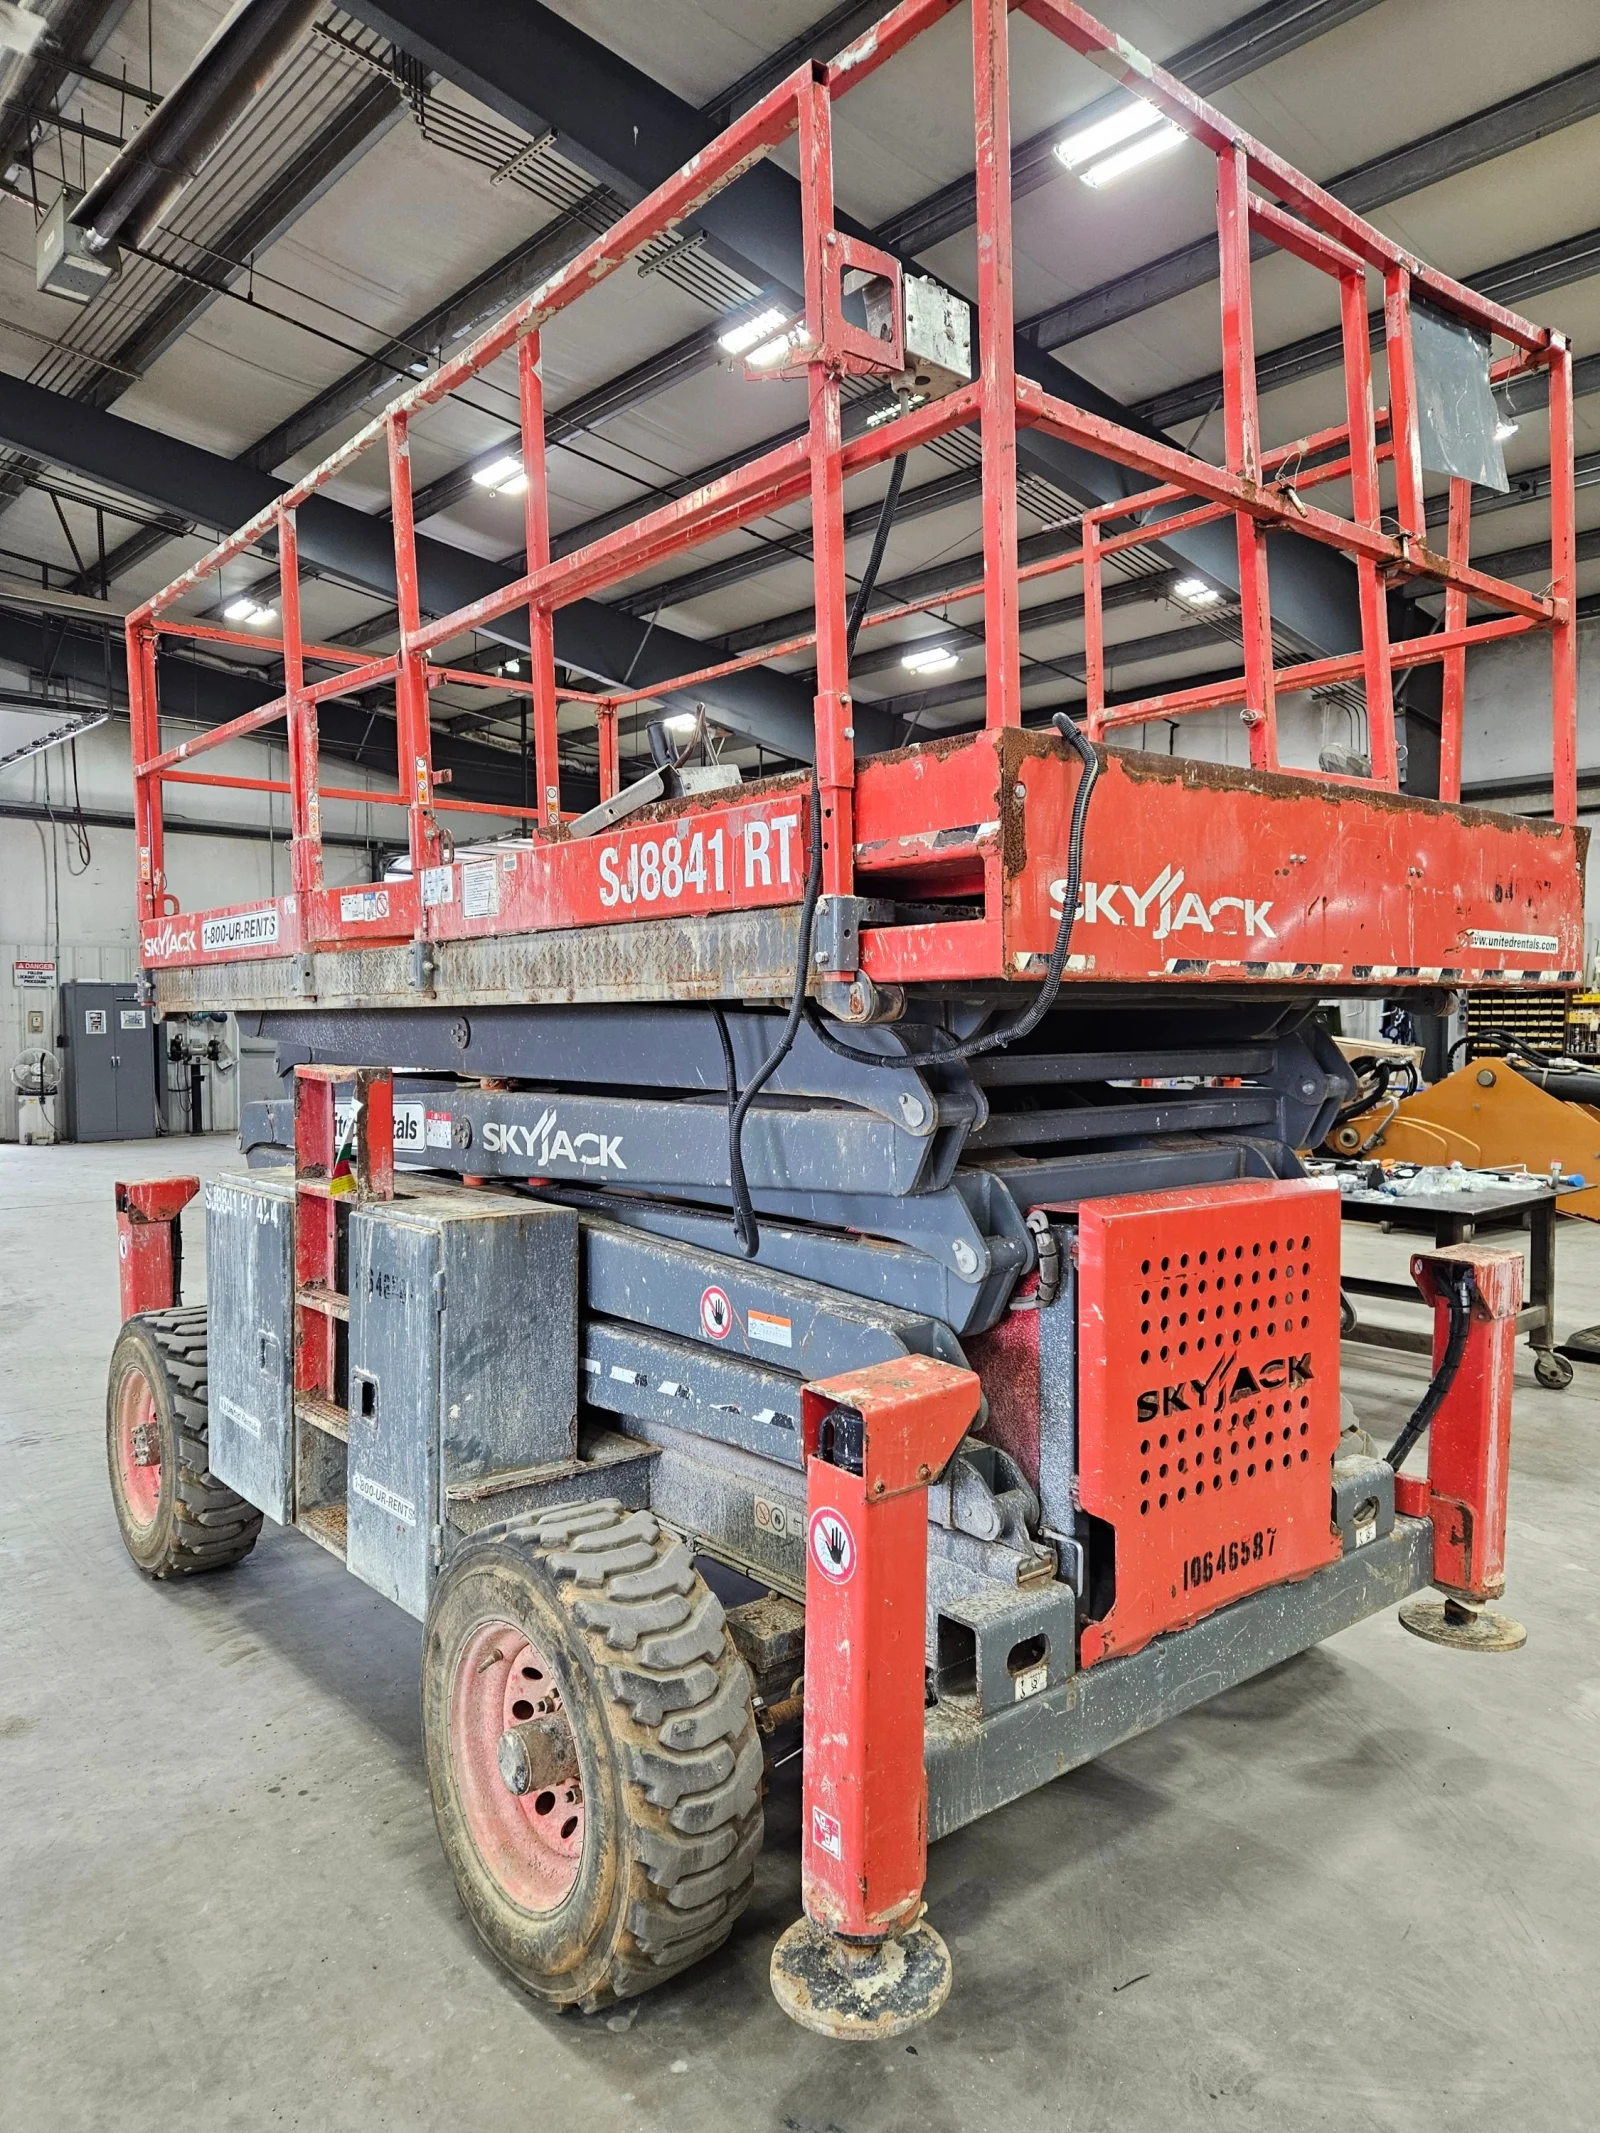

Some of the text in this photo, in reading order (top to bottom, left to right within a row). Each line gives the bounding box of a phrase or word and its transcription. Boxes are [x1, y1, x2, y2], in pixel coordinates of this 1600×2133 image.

[600, 814, 798, 907] SJ8841 RT
[203, 915, 276, 945] 1-800-UR-RENTS
[1049, 863, 1277, 940] SKYJACK
[144, 922, 197, 959] SKYJACK
[482, 1105, 627, 1169] SKYJACK
[1137, 1350, 1314, 1423] SKYJACK
[355, 1476, 415, 1520] 1-800-UR-RENTS
[1183, 1527, 1277, 1591] 10646587
